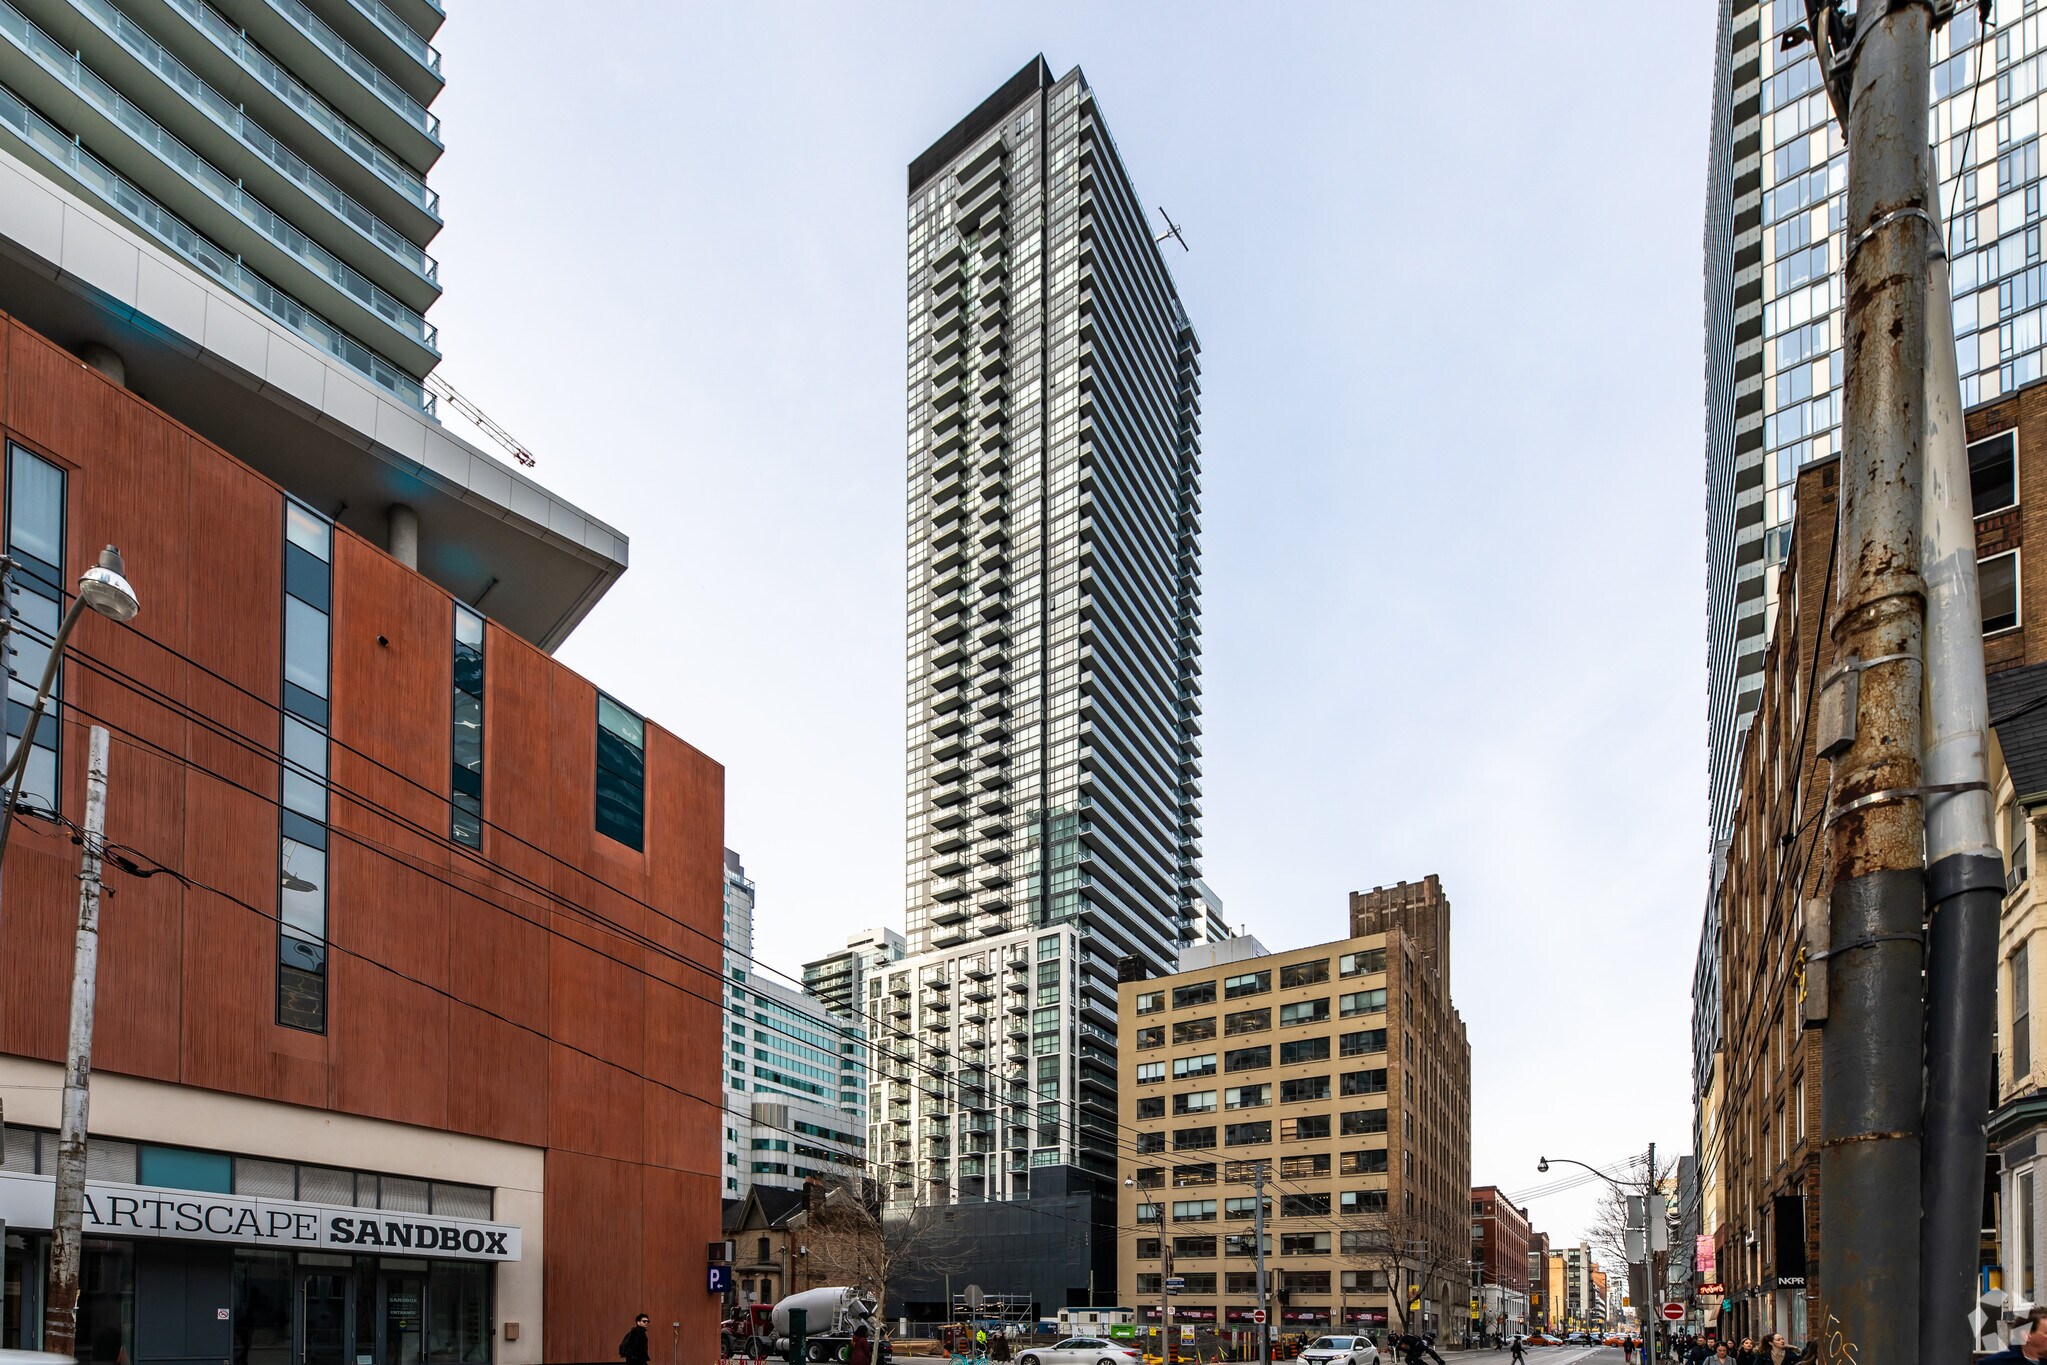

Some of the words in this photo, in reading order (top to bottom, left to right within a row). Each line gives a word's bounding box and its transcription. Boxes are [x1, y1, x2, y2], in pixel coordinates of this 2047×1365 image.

[82, 1193, 317, 1241] ARTSCAPE
[330, 1217, 508, 1255] SANDBOX
[710, 1269, 720, 1290] P
[1778, 1277, 1805, 1285] NKPR
